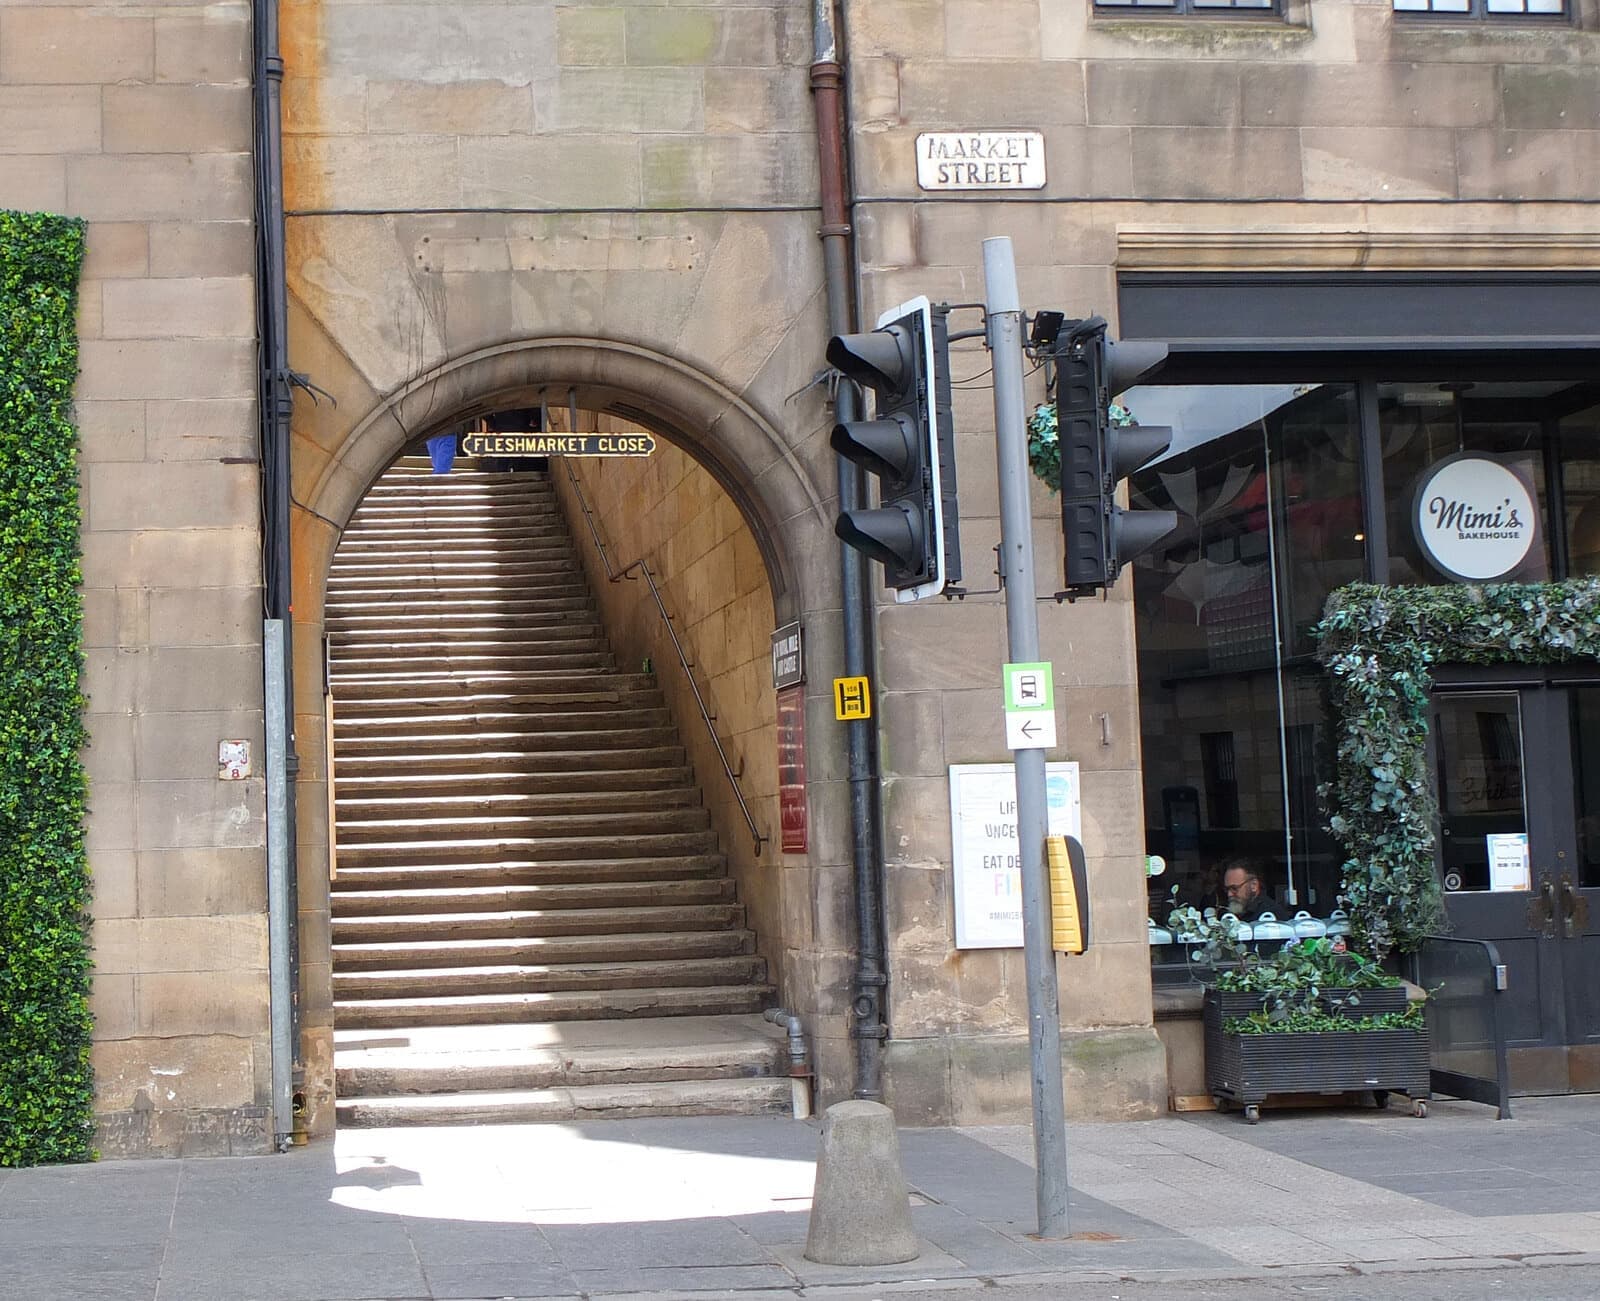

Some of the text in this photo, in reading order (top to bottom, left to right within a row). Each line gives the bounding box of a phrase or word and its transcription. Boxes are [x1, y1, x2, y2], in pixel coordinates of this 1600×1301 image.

[928, 137, 1034, 159] MARKET
[938, 162, 1028, 184] STREET
[474, 437, 647, 452] FLESHMARKET CLOSE
[1429, 496, 1523, 533] Mimi's
[1458, 532, 1520, 540] BAKEHOUSE
[231, 768, 240, 778] 8
[999, 801, 1017, 815] LIF
[985, 824, 1019, 839] UNCE
[983, 855, 1022, 869] EAT DE
